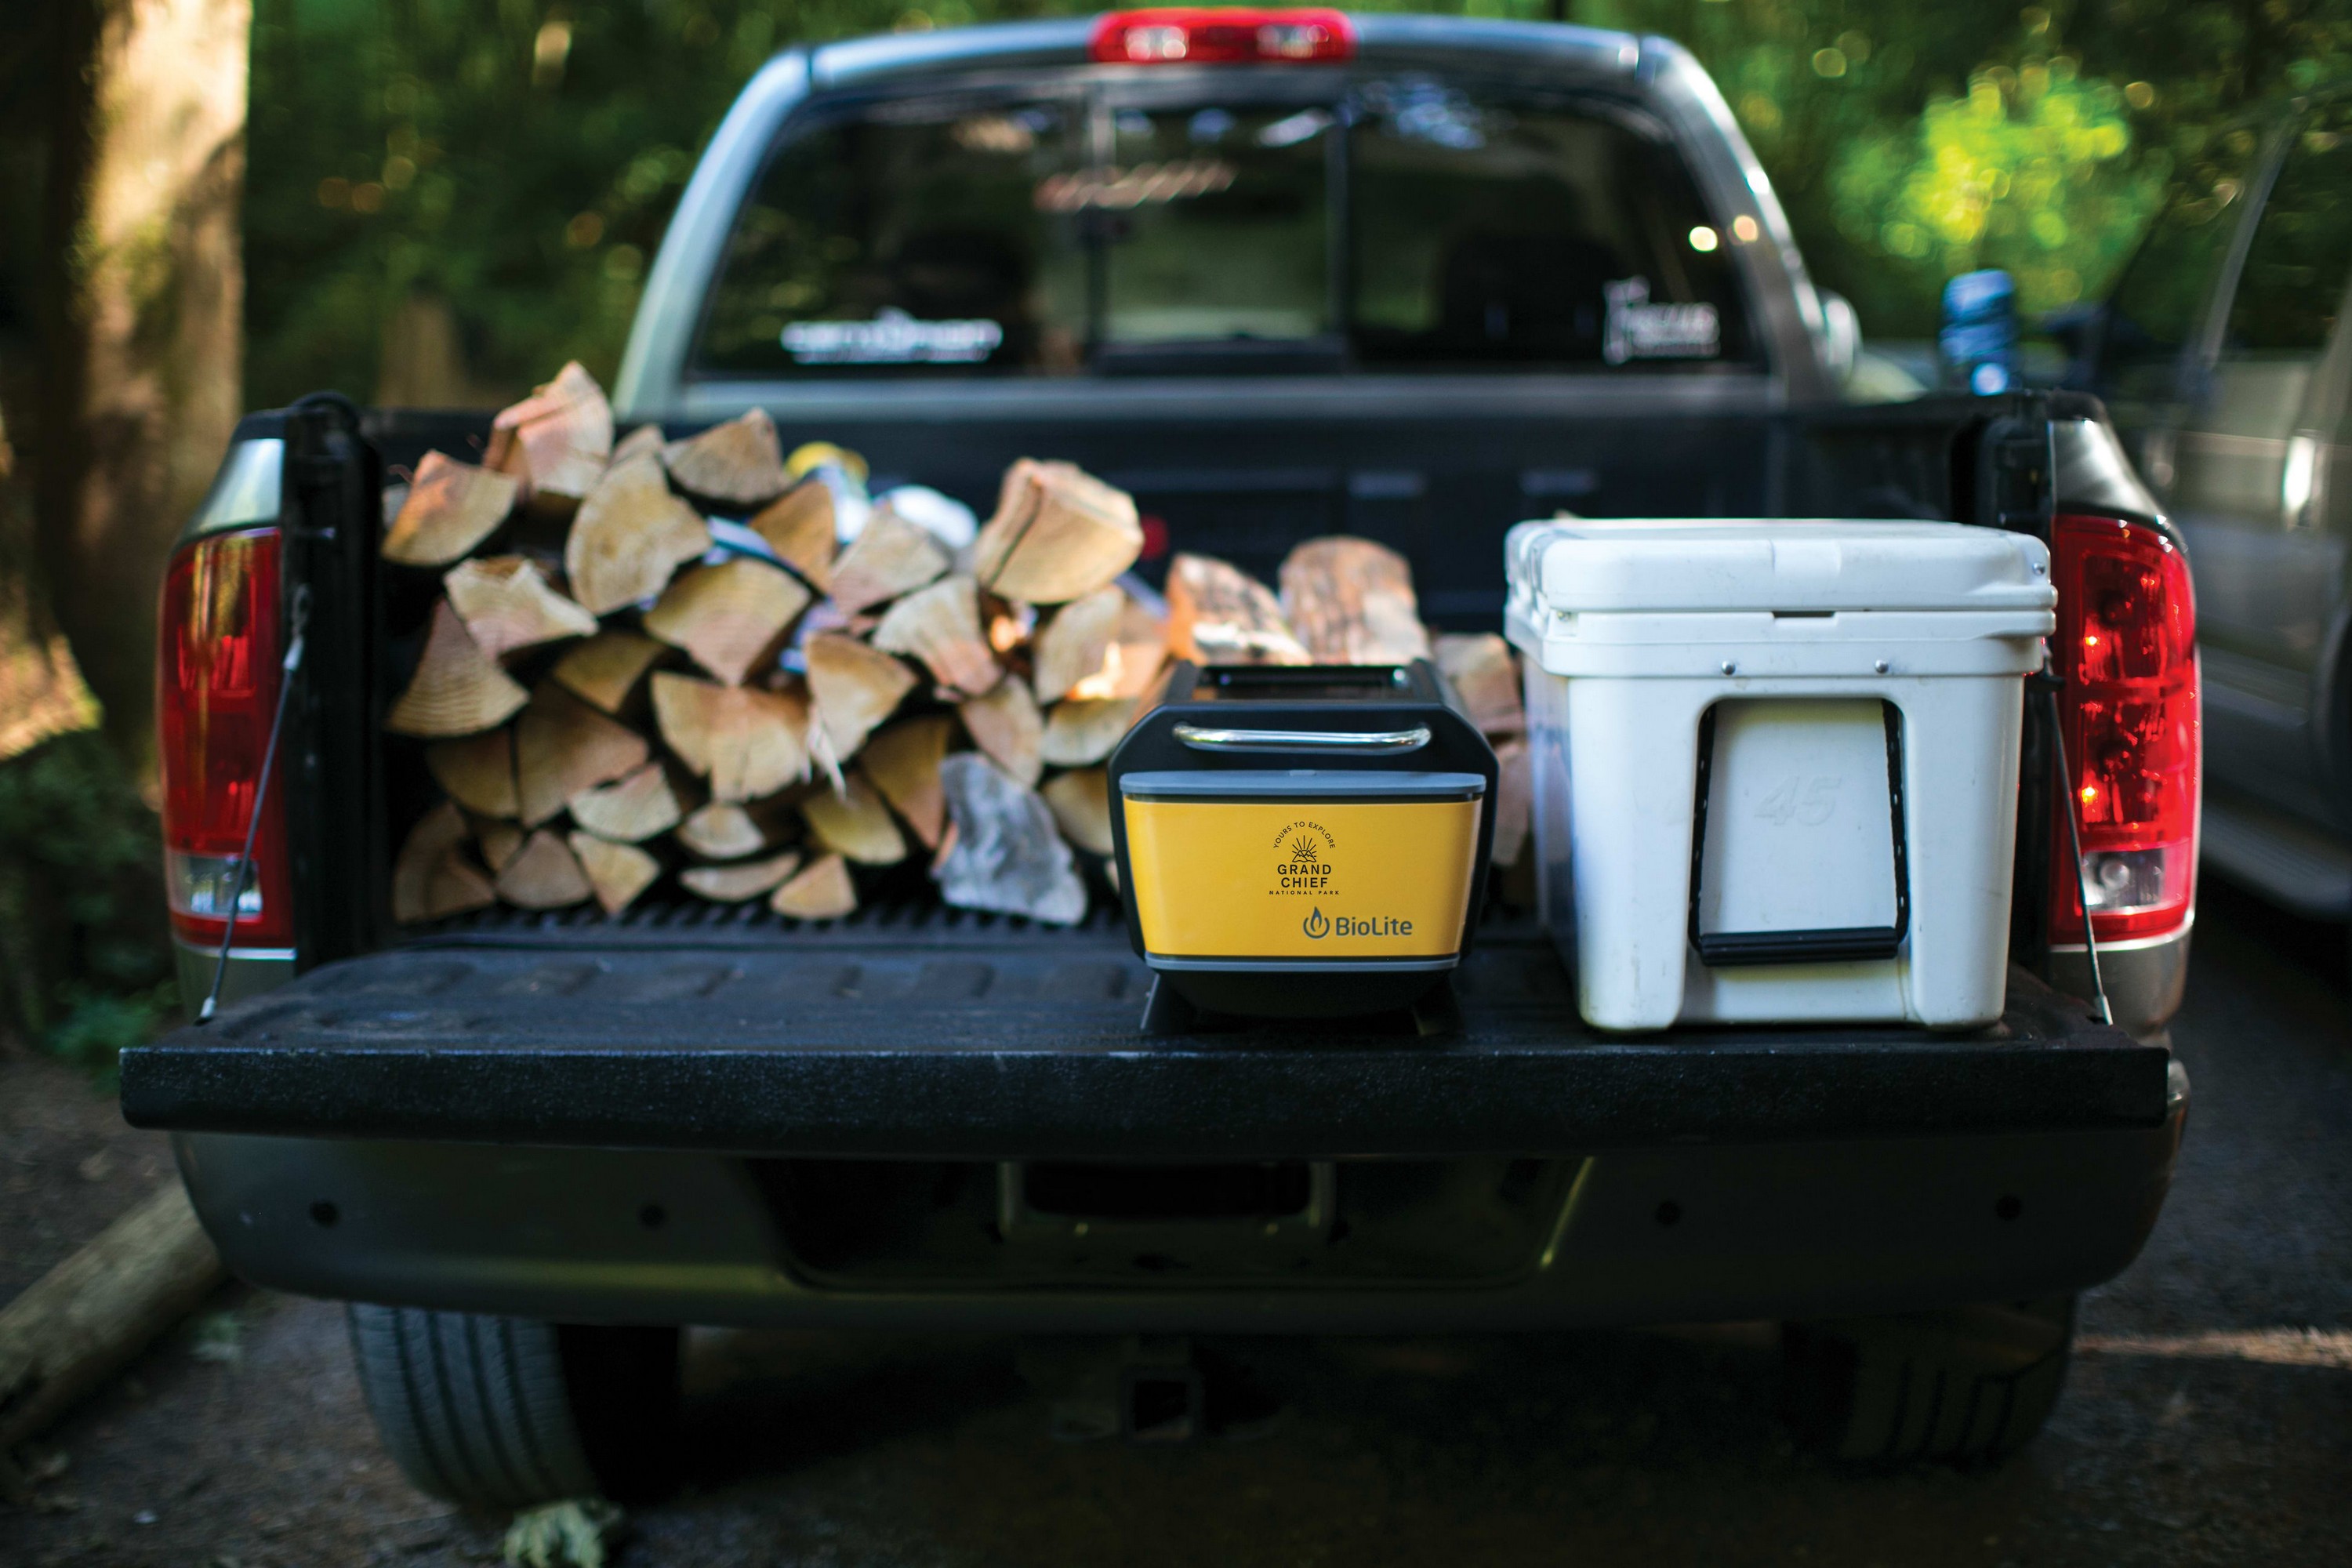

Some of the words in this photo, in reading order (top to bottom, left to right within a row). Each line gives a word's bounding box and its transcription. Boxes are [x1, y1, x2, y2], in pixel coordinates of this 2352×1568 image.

[1754, 775, 1842, 826] 45
[1273, 826, 1292, 848] YOURS
[1308, 822, 1336, 849] EXPLORE
[1277, 864, 1331, 875] GRAND
[1281, 877, 1328, 888] CHIEF
[1335, 916, 1413, 936] BioLite
